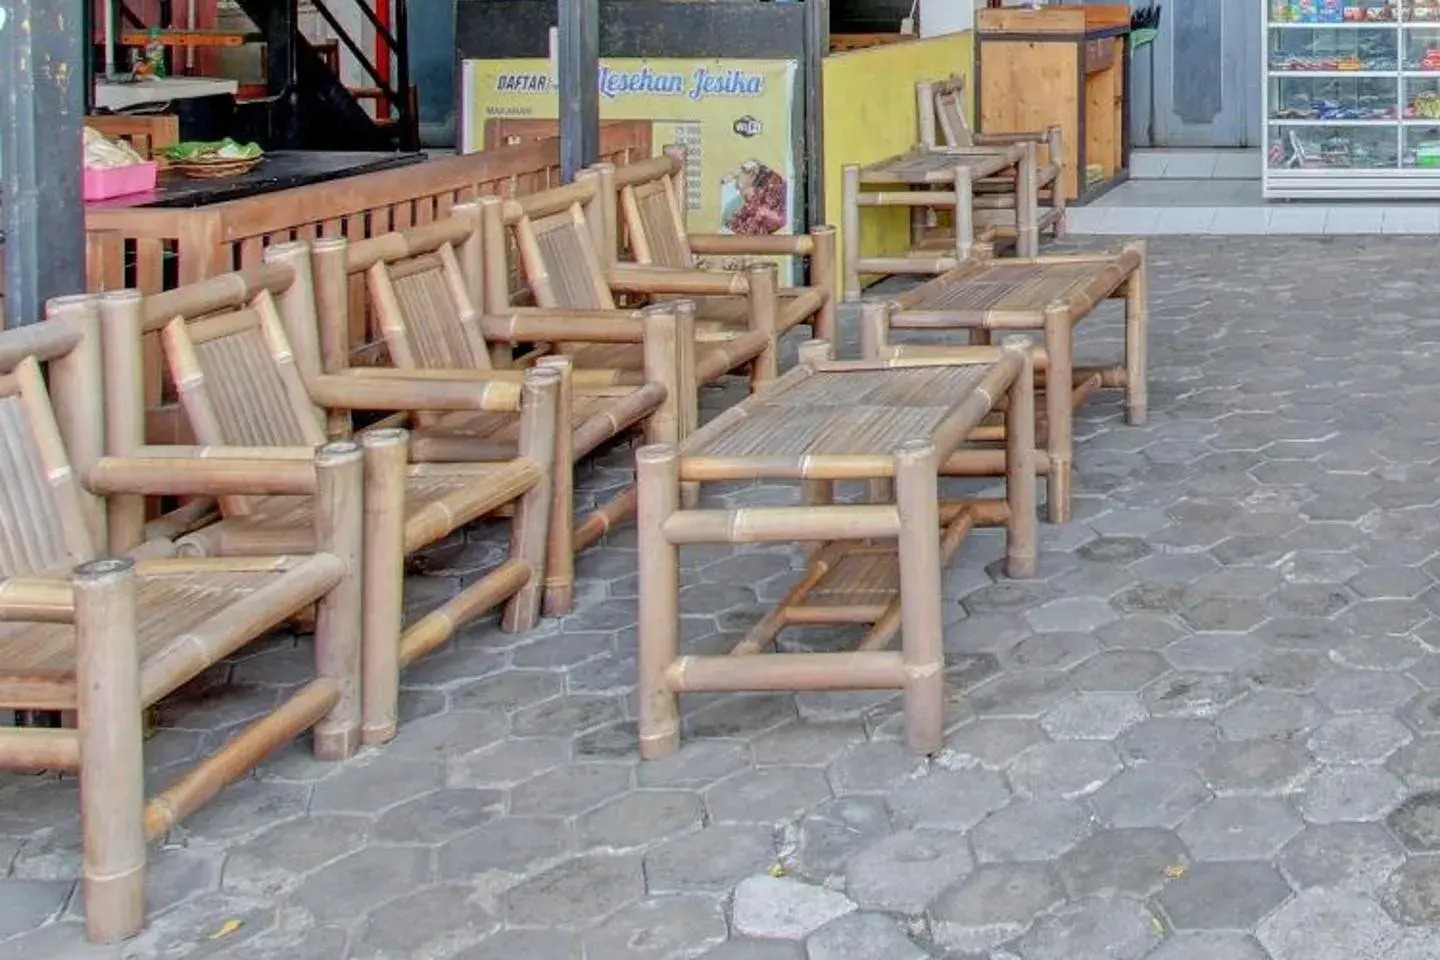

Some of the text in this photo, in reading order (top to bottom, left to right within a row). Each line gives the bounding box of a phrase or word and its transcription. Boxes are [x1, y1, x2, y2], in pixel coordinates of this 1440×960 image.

[497, 74, 547, 90] DAFTAR
[599, 66, 761, 100] Lesehan Jesika
